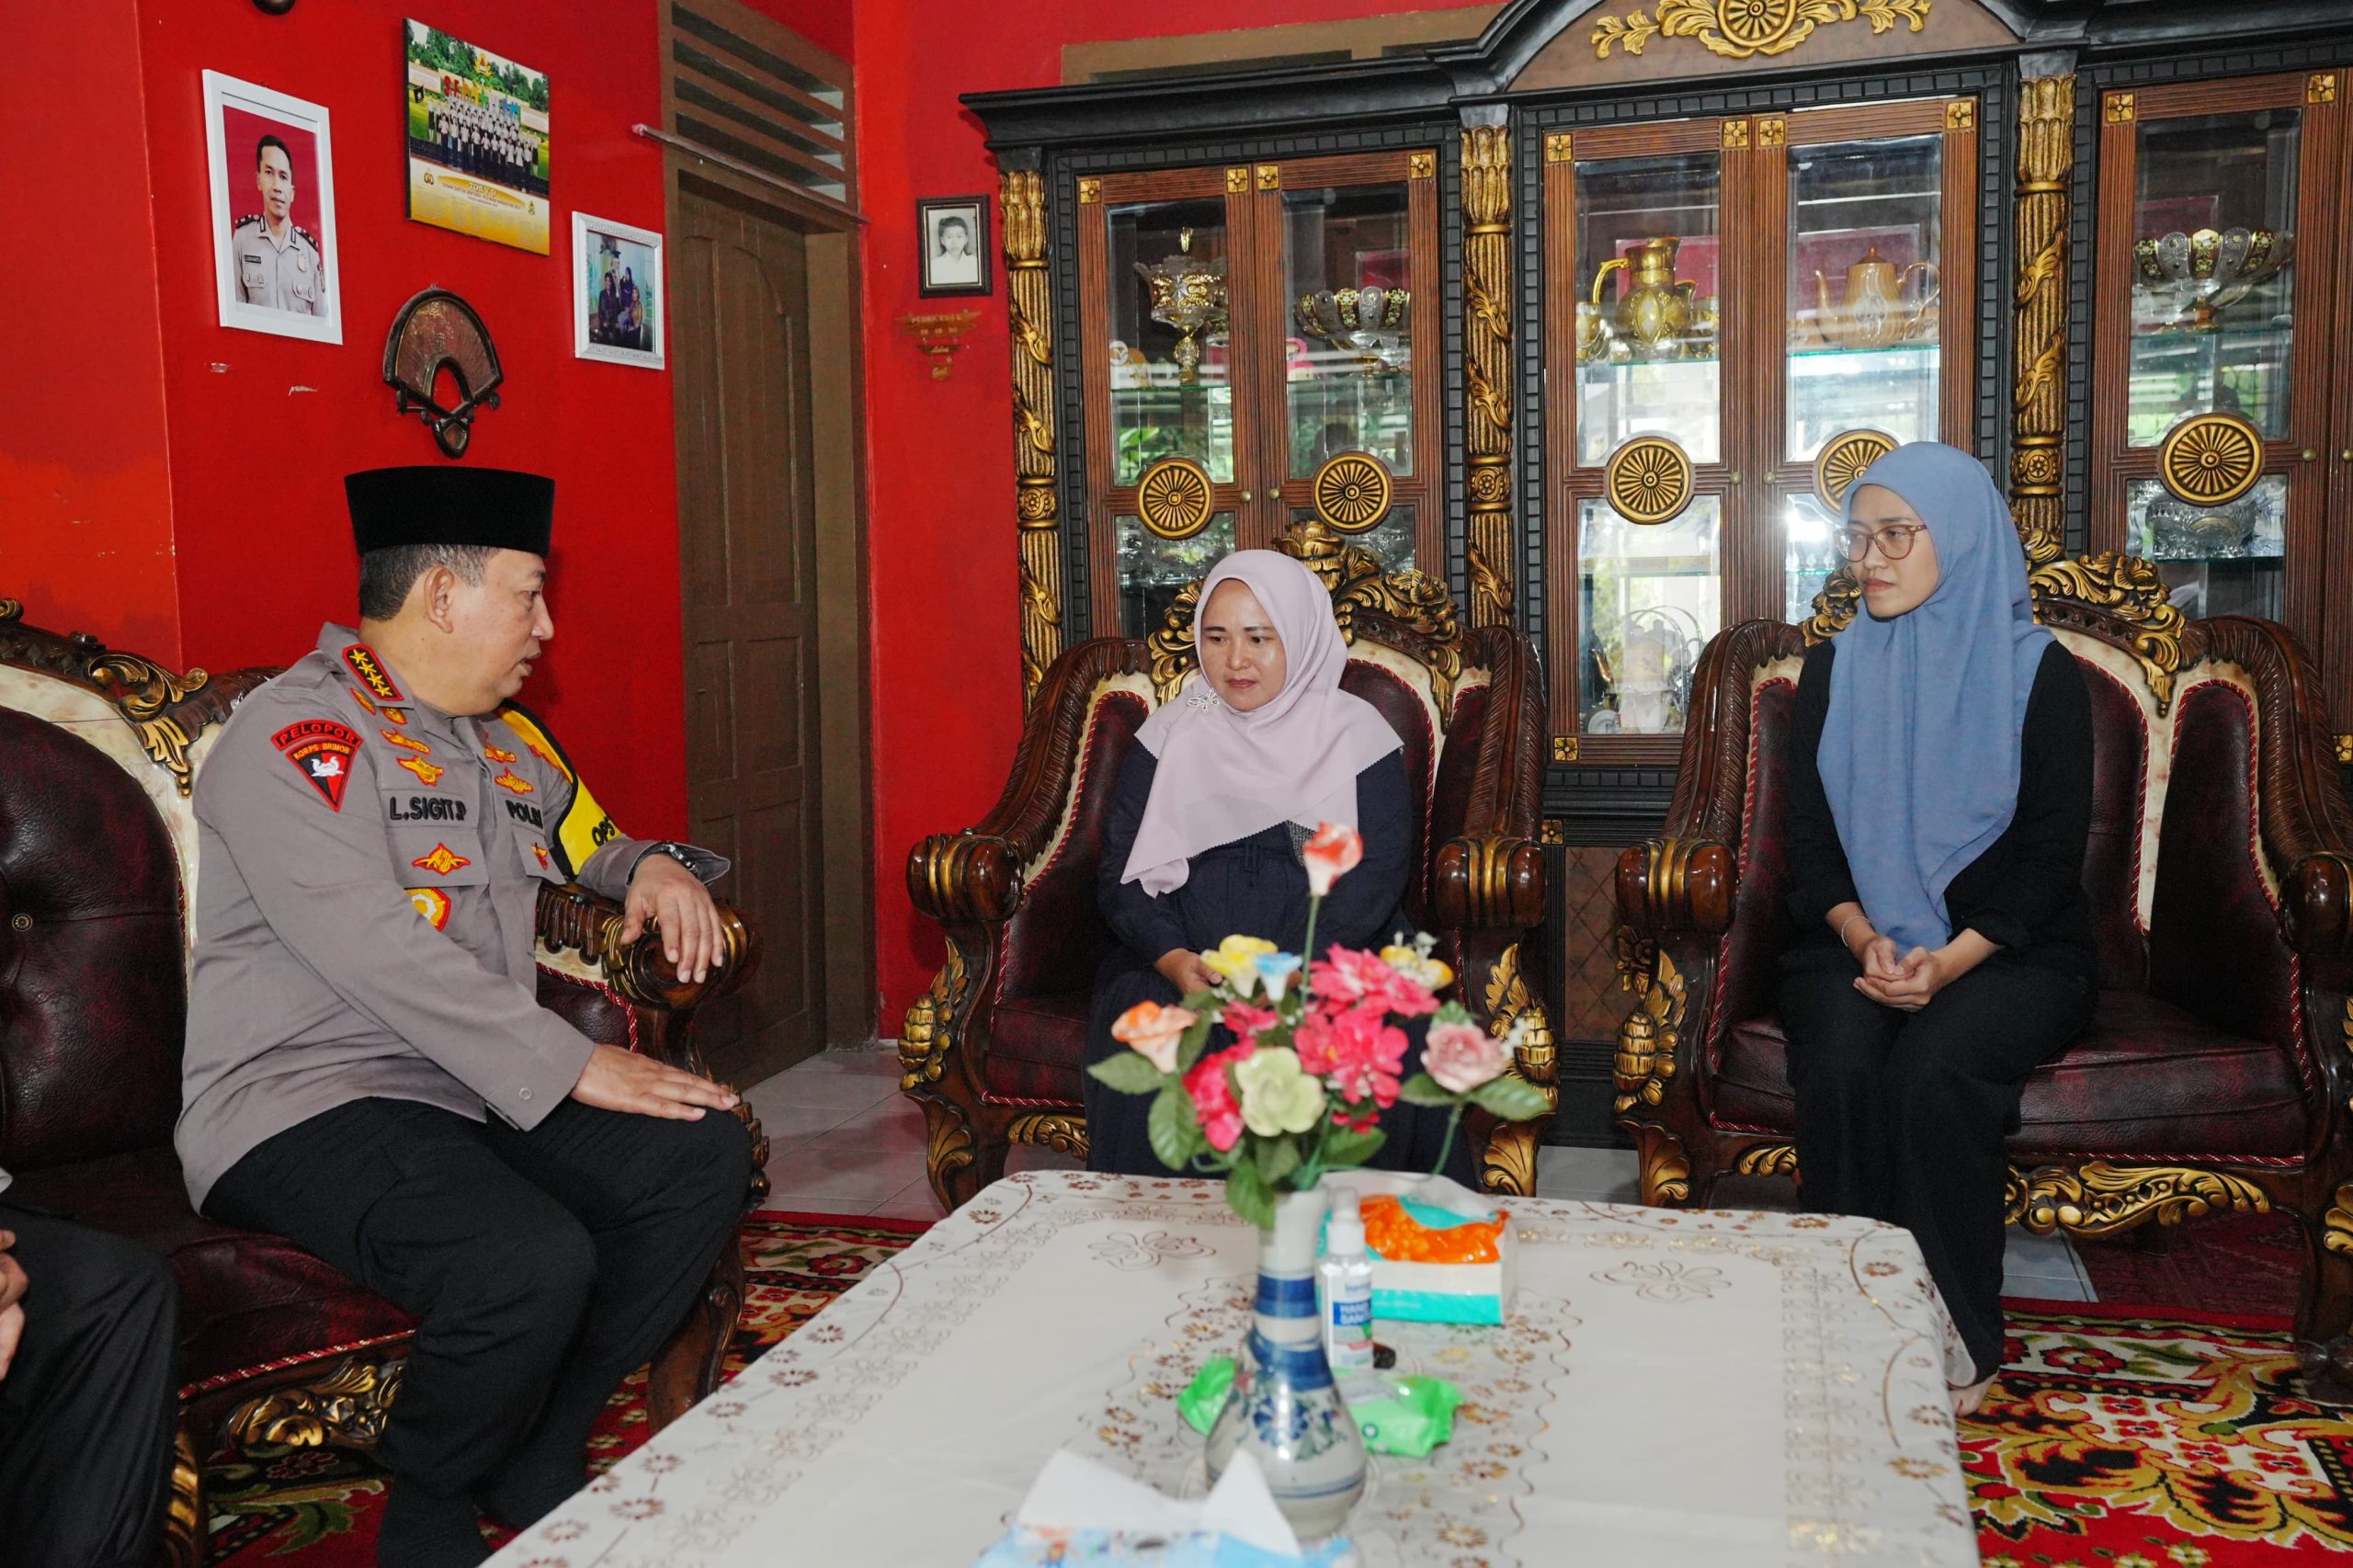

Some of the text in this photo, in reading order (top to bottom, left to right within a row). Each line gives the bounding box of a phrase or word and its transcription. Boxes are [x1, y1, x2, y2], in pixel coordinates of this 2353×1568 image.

[278, 723, 357, 744] PELOPOR
[293, 743, 349, 760] KORPS BRIMOB
